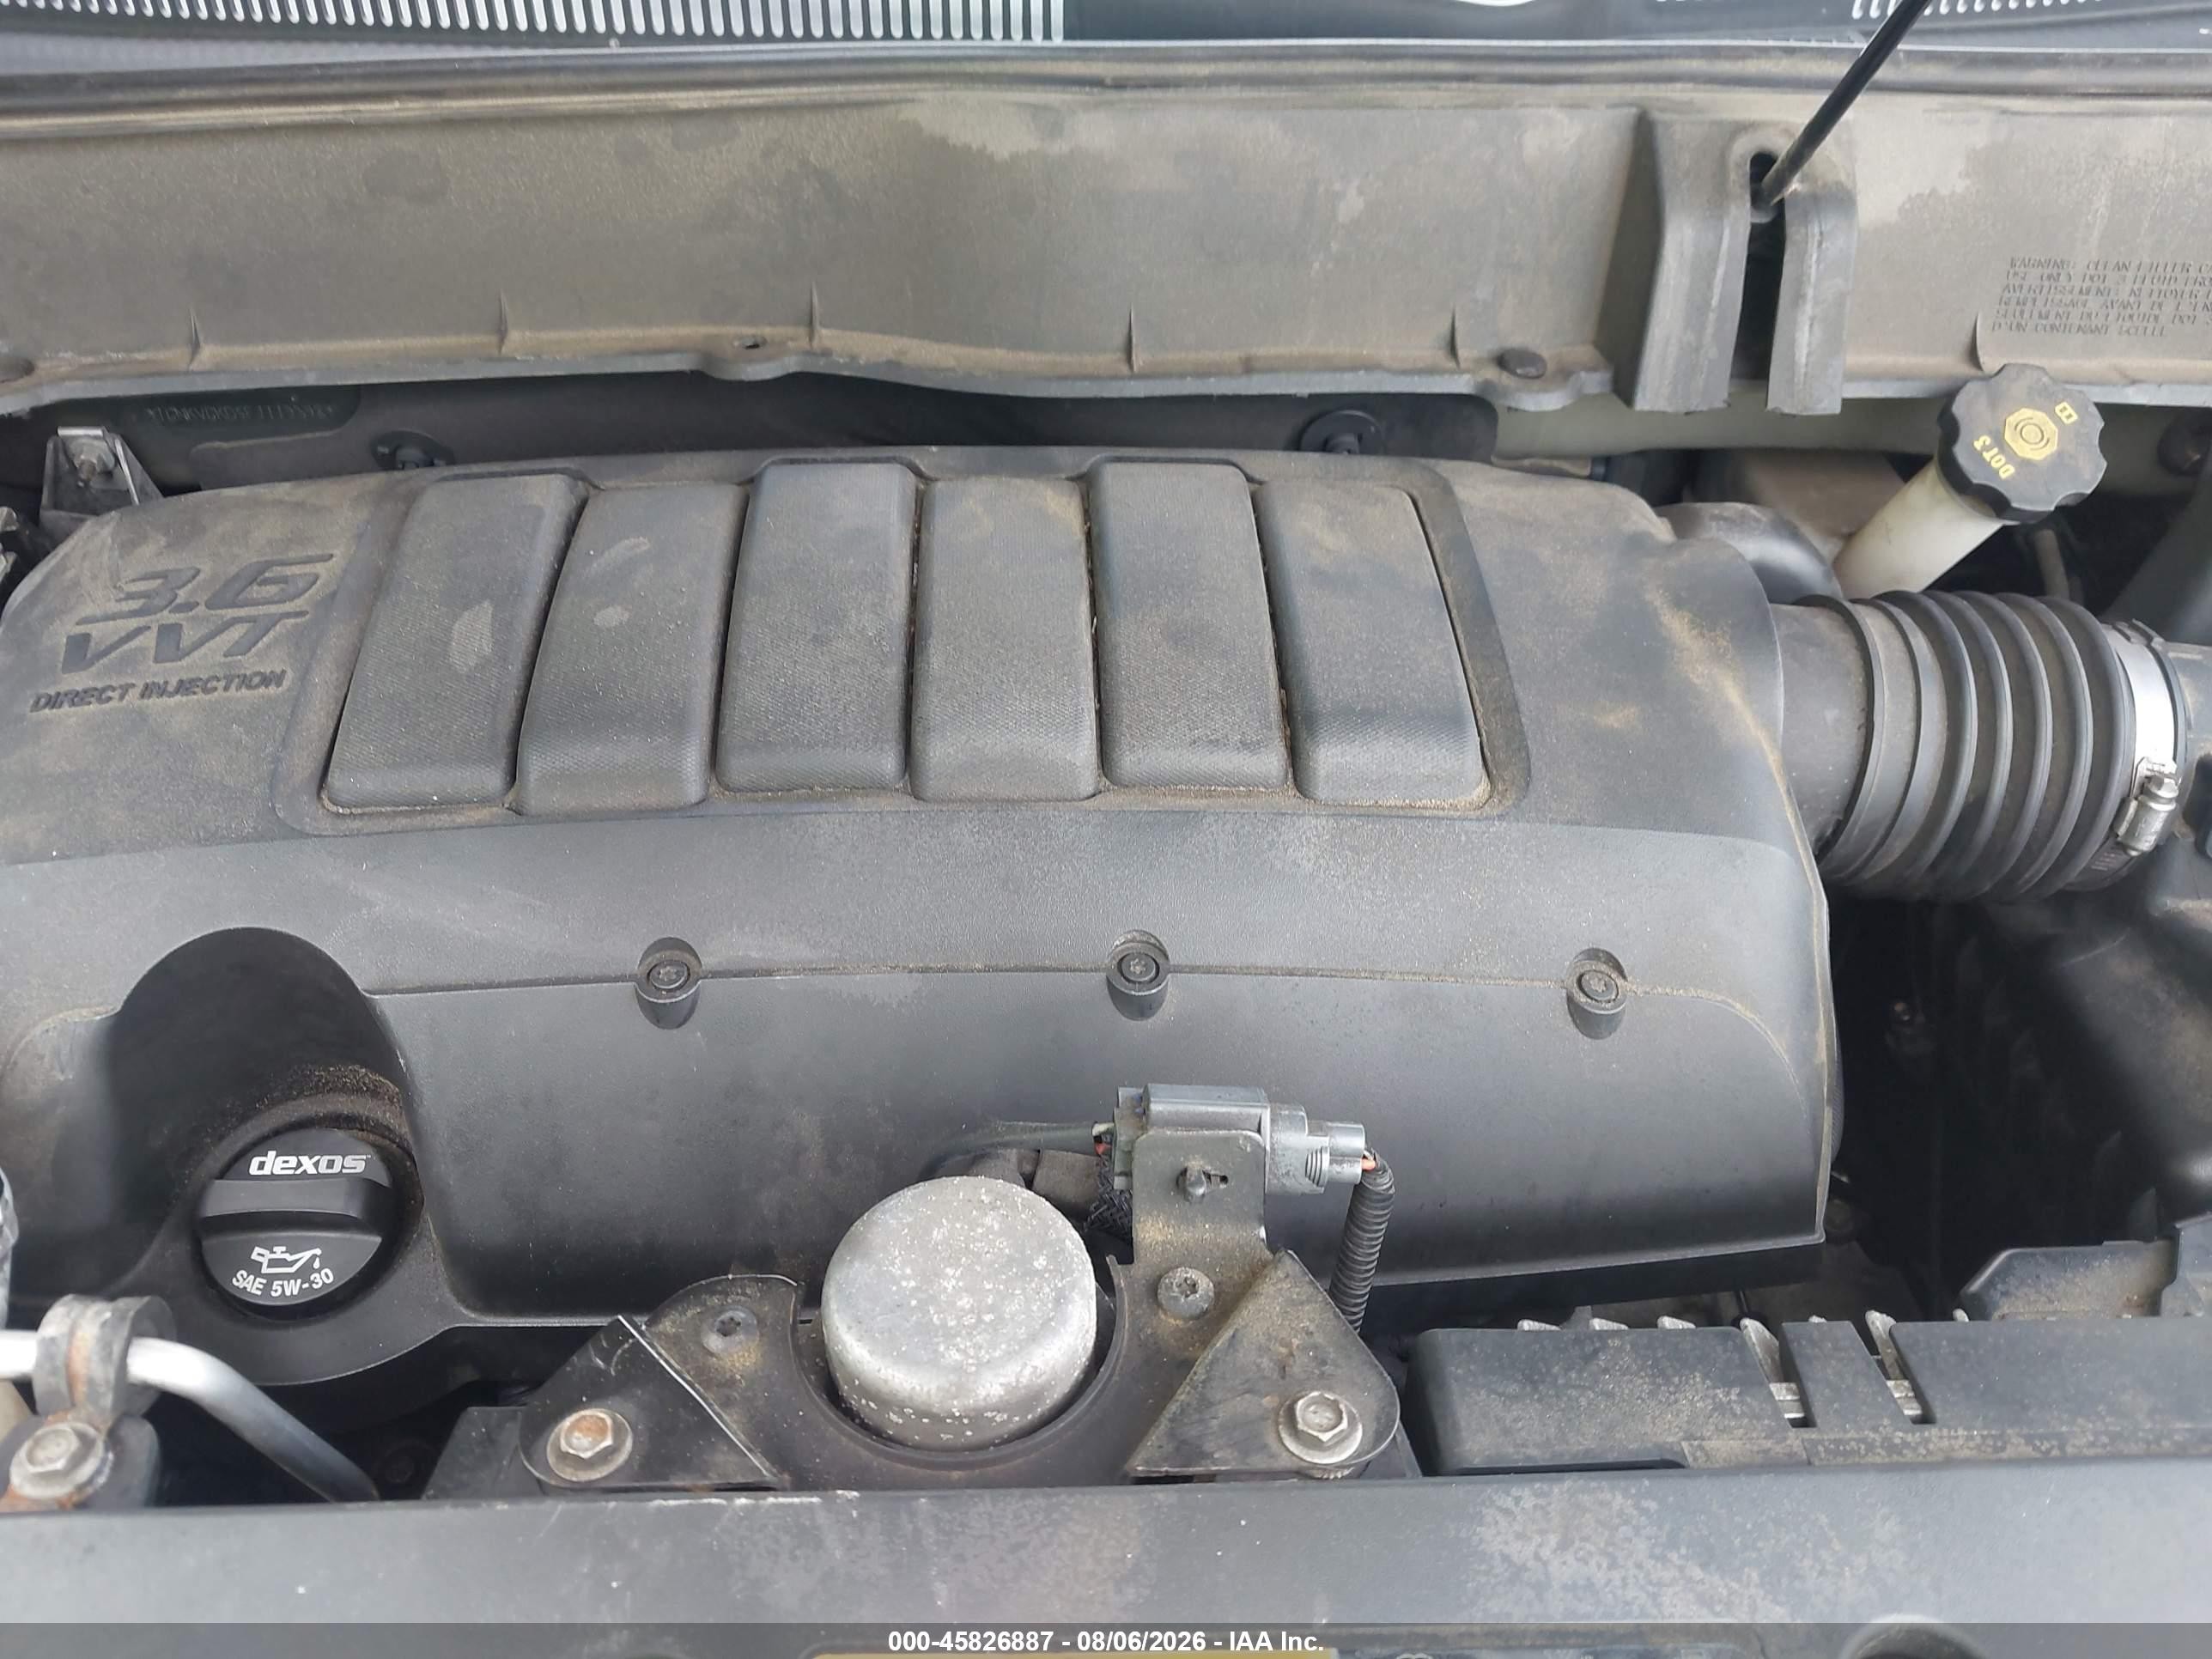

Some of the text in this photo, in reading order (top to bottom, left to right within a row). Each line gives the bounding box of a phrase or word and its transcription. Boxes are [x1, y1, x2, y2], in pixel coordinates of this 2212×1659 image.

[76, 553, 335, 625] 3.6
[61, 610, 310, 675] VVT
[30, 670, 288, 714] DIRECT INJECTION
[232, 1267, 334, 1297] SAE 5W-30
